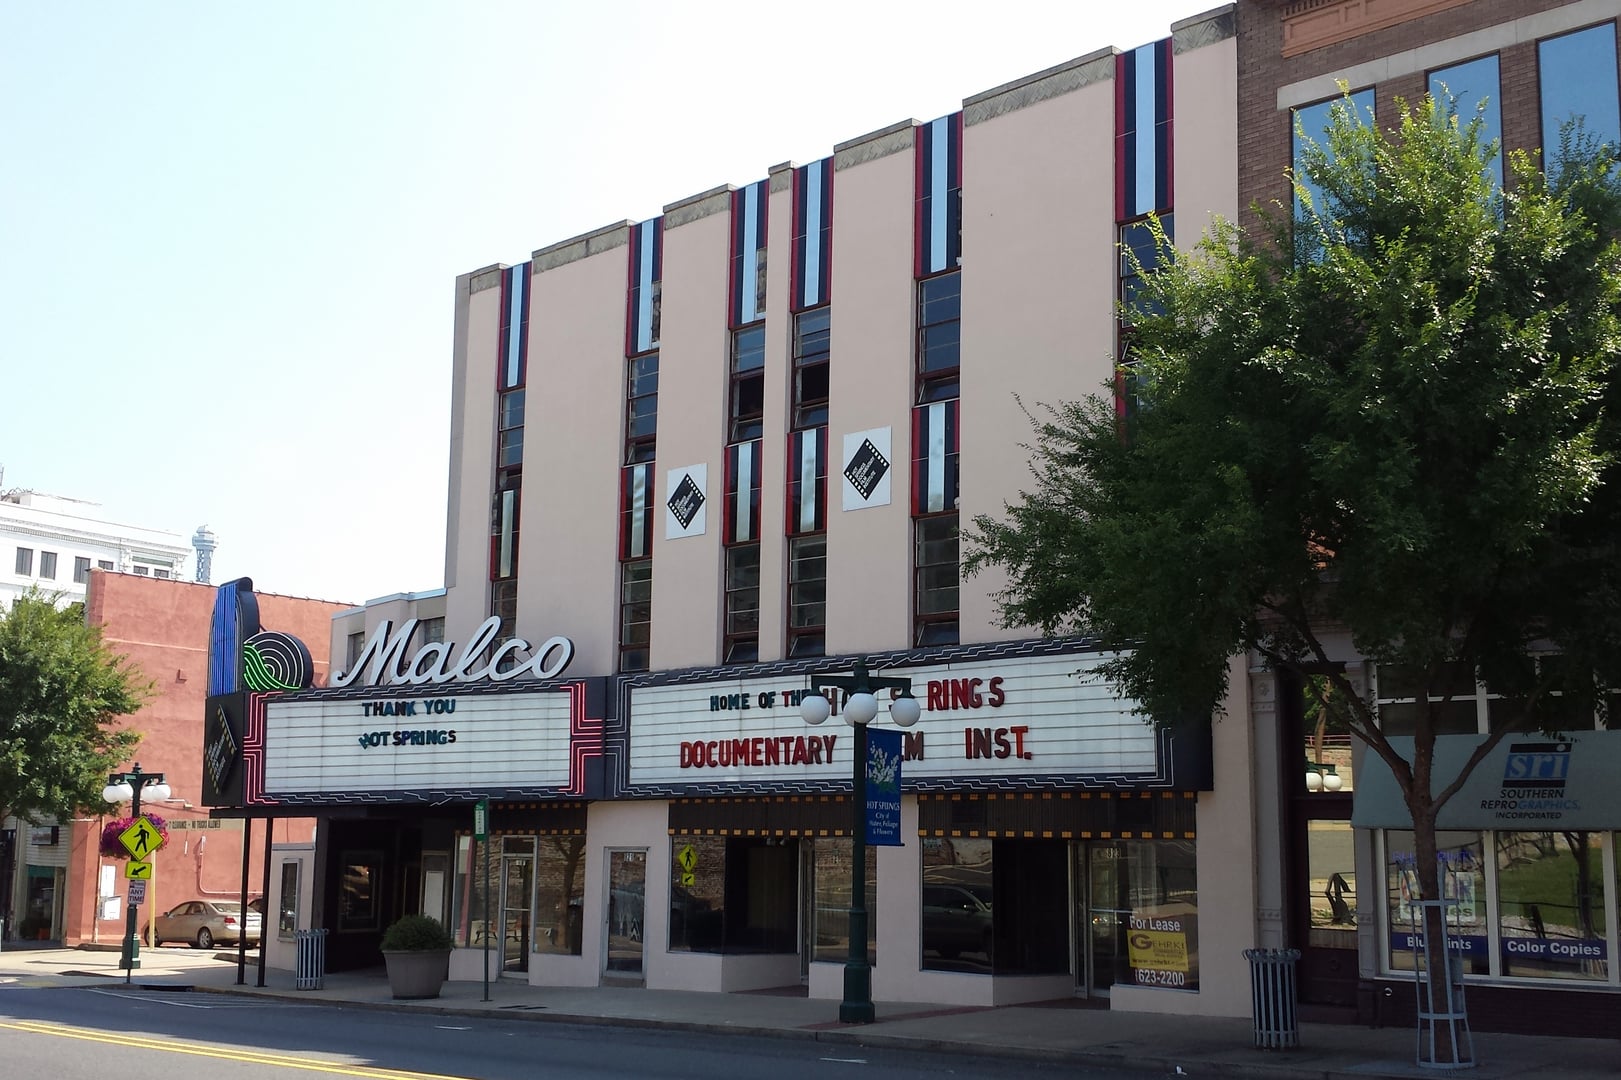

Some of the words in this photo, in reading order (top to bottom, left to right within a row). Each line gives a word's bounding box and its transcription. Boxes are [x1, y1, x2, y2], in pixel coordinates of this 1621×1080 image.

[331, 615, 575, 688] Malco
[362, 700, 416, 717] THANK
[423, 699, 456, 715] YOU
[710, 692, 750, 712] HOME
[758, 691, 776, 709] OF
[358, 730, 391, 750] HOT
[392, 729, 457, 746] SPRINGS
[680, 734, 838, 768] DOCUMENTARY
[965, 725, 1033, 760] INST.
[1500, 789, 1565, 799] SOUTHERN
[1129, 915, 1147, 929] For
[1149, 916, 1181, 931] Lease
[1407, 936, 1472, 950] Bluints
[1507, 941, 1546, 953] Color
[1550, 942, 1601, 957] Copies
